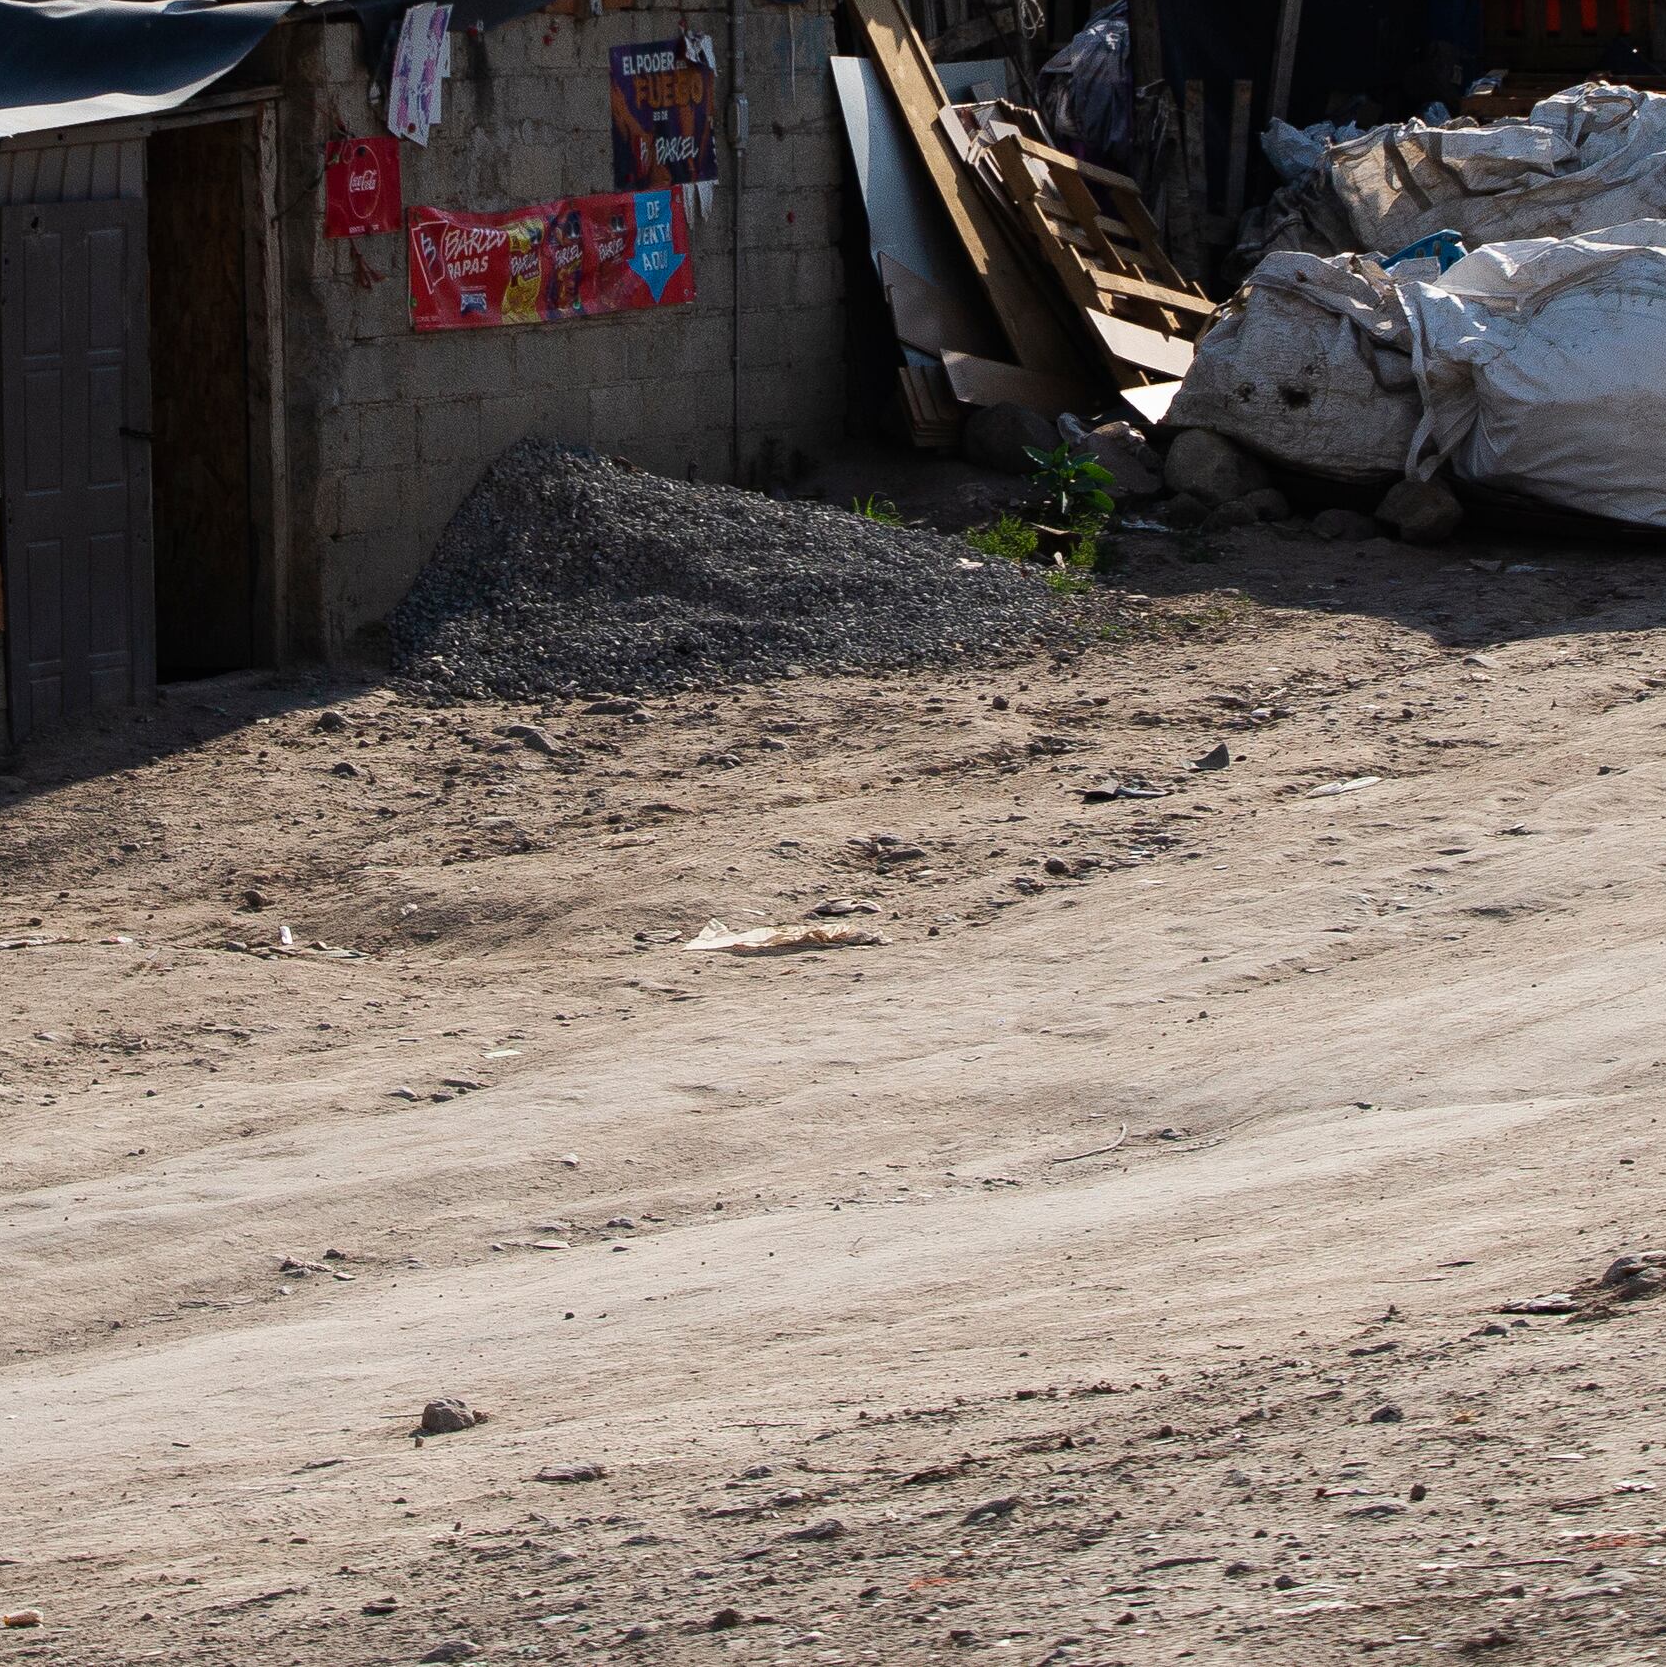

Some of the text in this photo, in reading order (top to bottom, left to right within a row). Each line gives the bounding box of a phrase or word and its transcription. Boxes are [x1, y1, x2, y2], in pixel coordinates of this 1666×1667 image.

[622, 55, 636, 76] EL
[636, 51, 675, 74] PODER
[634, 71, 704, 109] FUEGO
[655, 136, 700, 165] BARCEL
[646, 200, 660, 221] DE
[447, 255, 489, 281] PAPAS
